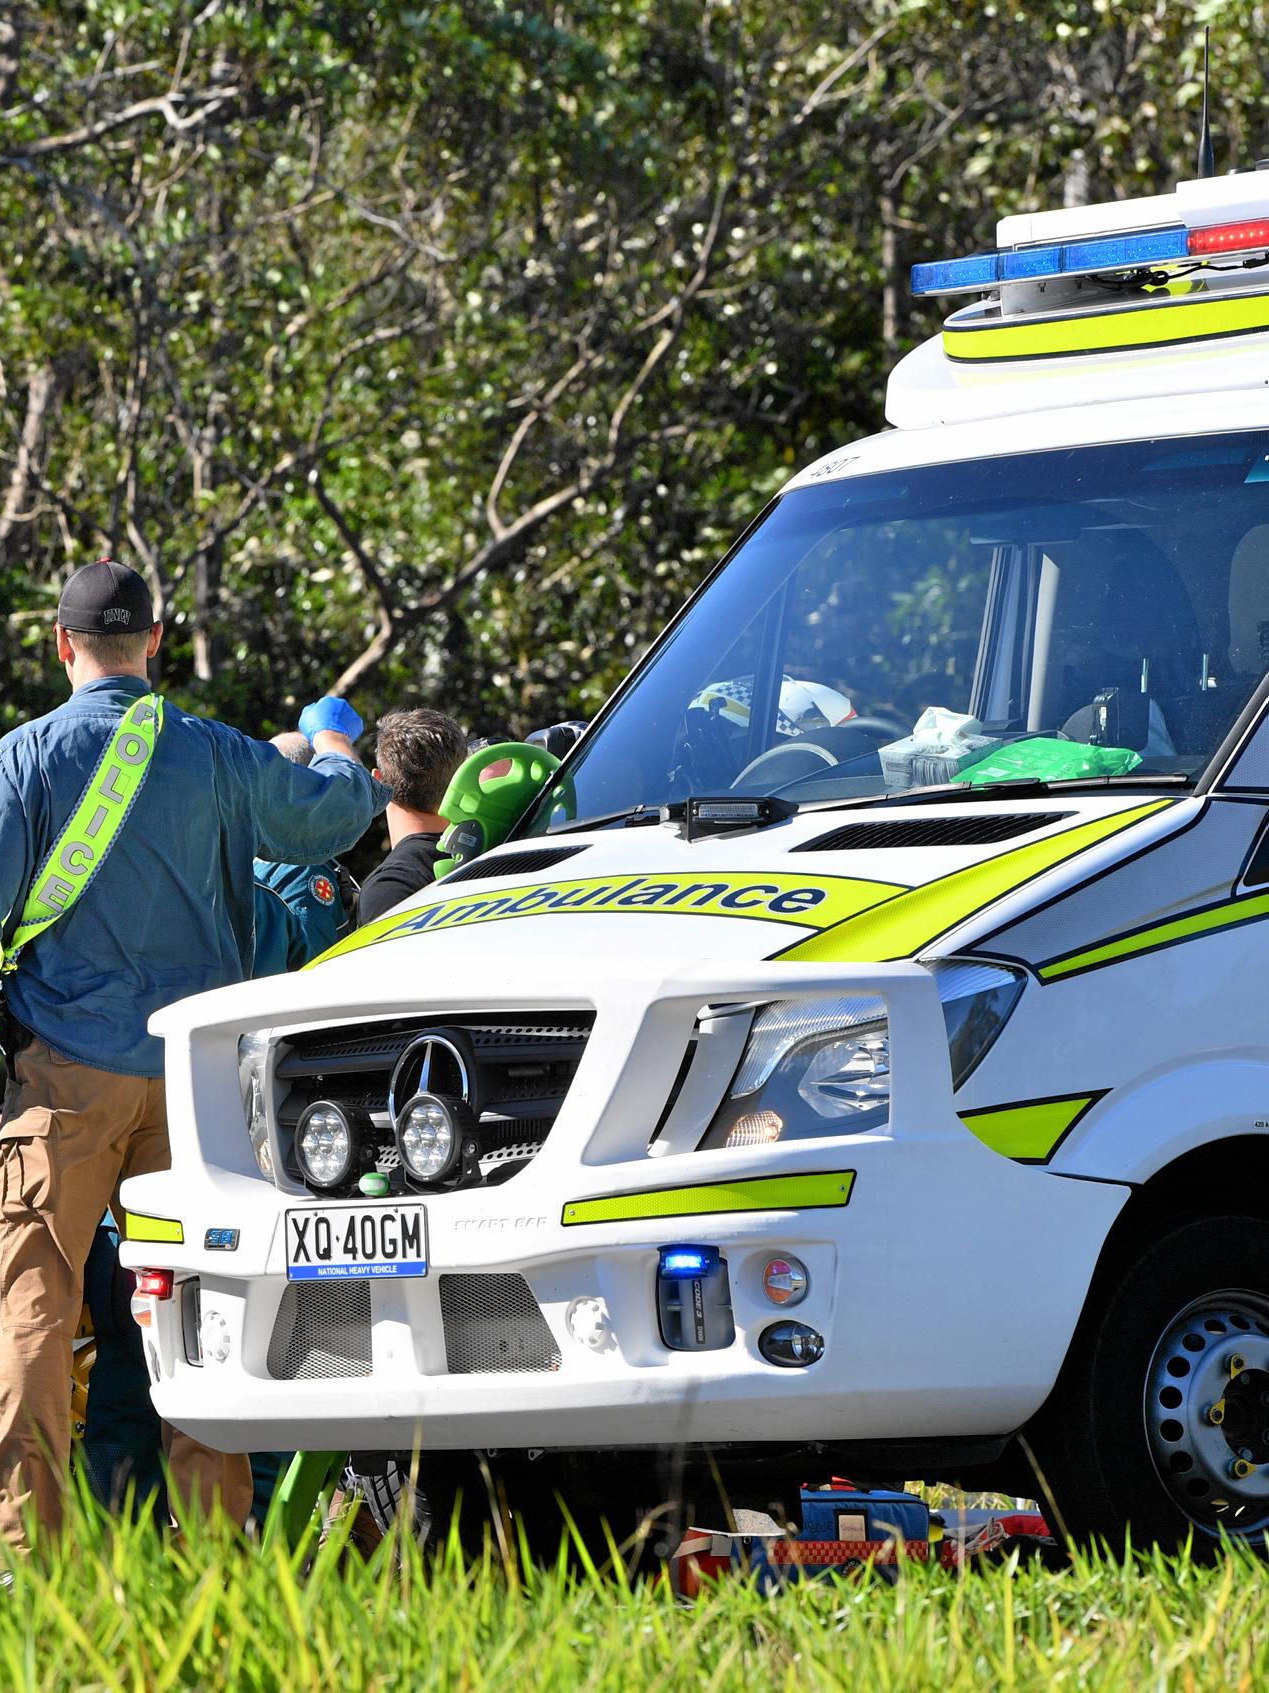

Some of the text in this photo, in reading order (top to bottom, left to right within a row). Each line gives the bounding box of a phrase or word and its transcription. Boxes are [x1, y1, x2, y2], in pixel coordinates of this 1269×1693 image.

[35, 701, 155, 913] POLICE
[376, 878, 827, 940] Ambulance
[318, 1265, 397, 1275] NATIONAL HEAVY VEHICLE
[694, 1281, 702, 1310] CODE
